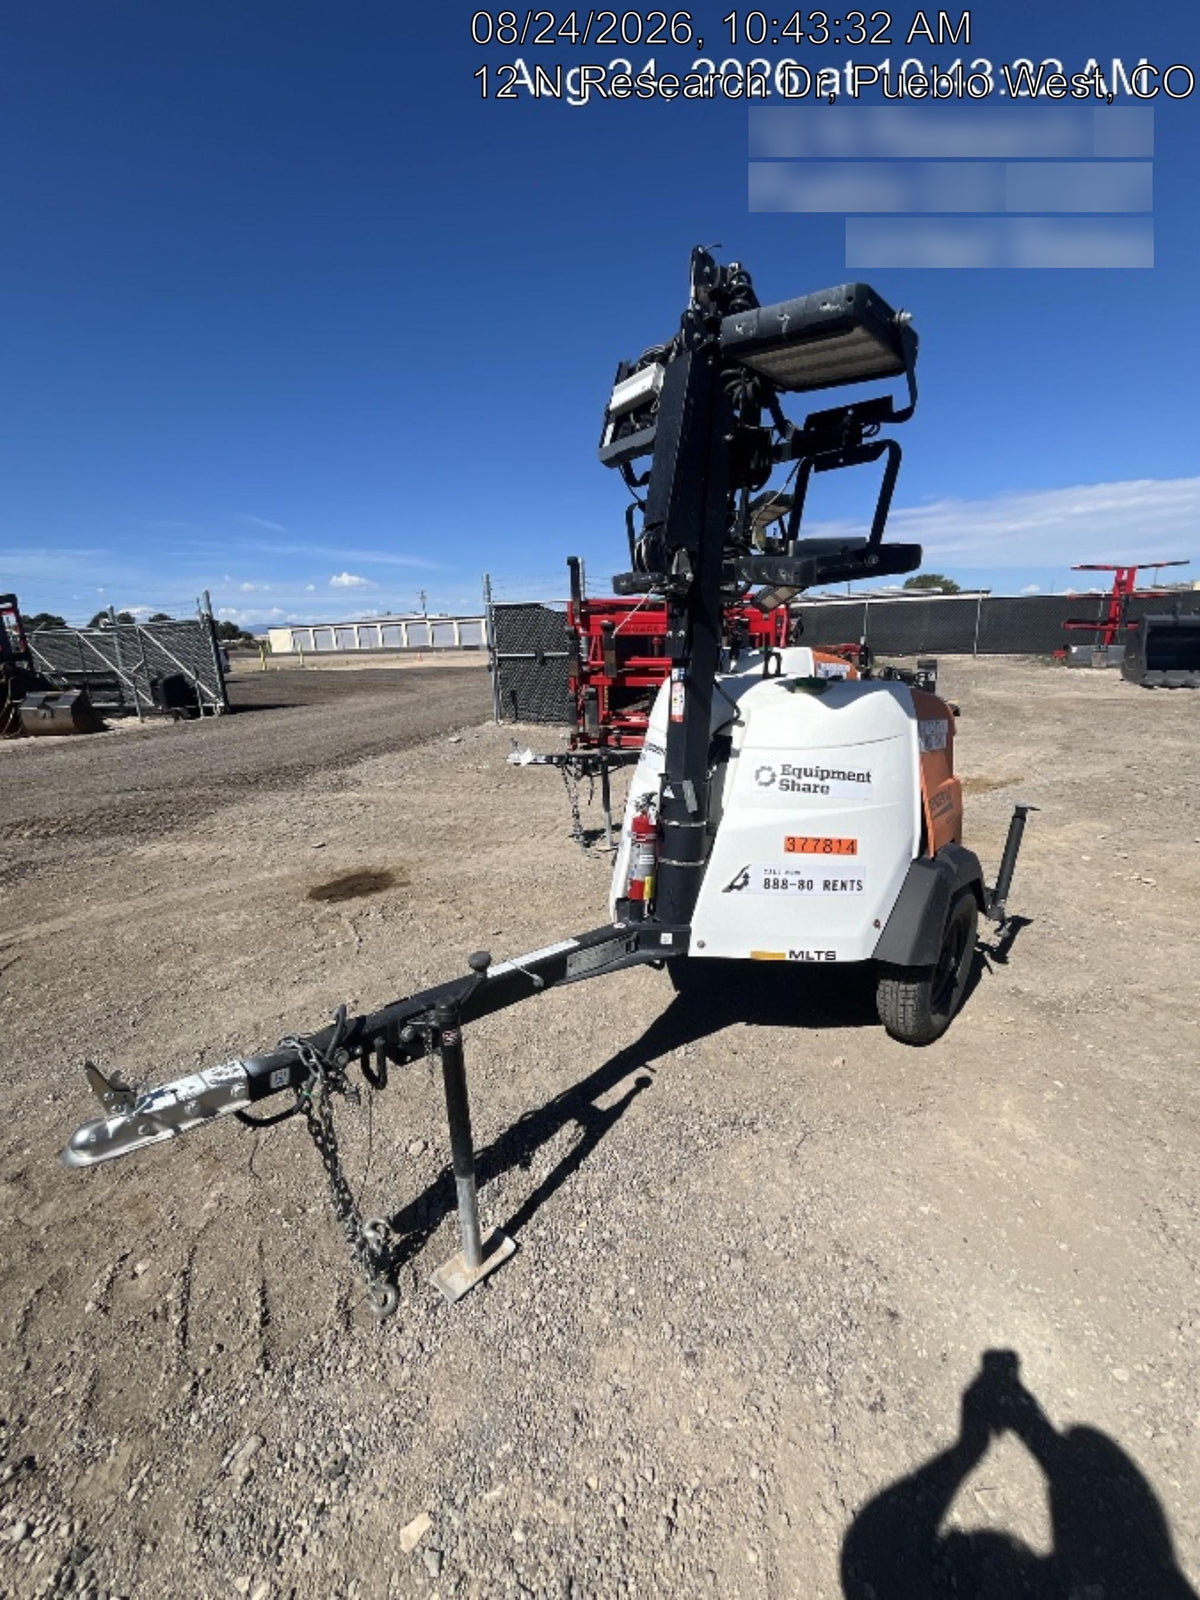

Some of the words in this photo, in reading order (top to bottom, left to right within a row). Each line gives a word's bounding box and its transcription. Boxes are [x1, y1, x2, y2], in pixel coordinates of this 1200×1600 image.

[780, 763, 872, 784] Equipment
[778, 778, 830, 795] Share
[786, 837, 856, 855] 377814
[763, 877, 814, 891] 888-80
[823, 879, 864, 892] RENTS
[789, 950, 837, 961] MLTS
